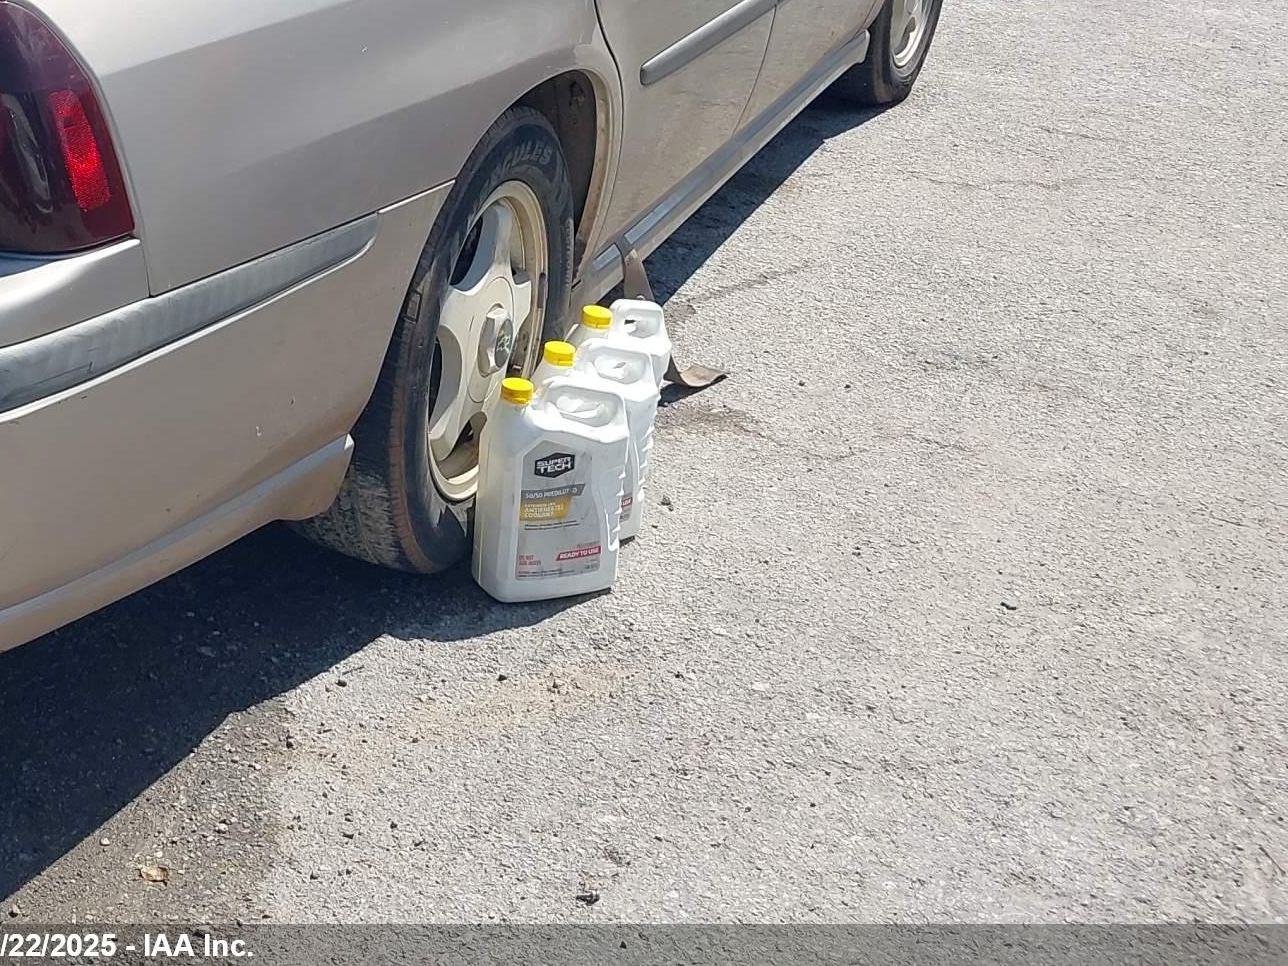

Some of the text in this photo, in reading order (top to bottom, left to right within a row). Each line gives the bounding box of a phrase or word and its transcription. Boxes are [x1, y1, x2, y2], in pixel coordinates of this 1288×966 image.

[536, 461, 572, 474] TECH
[537, 456, 572, 467] SUPER
[559, 545, 600, 559] READY TO USE
